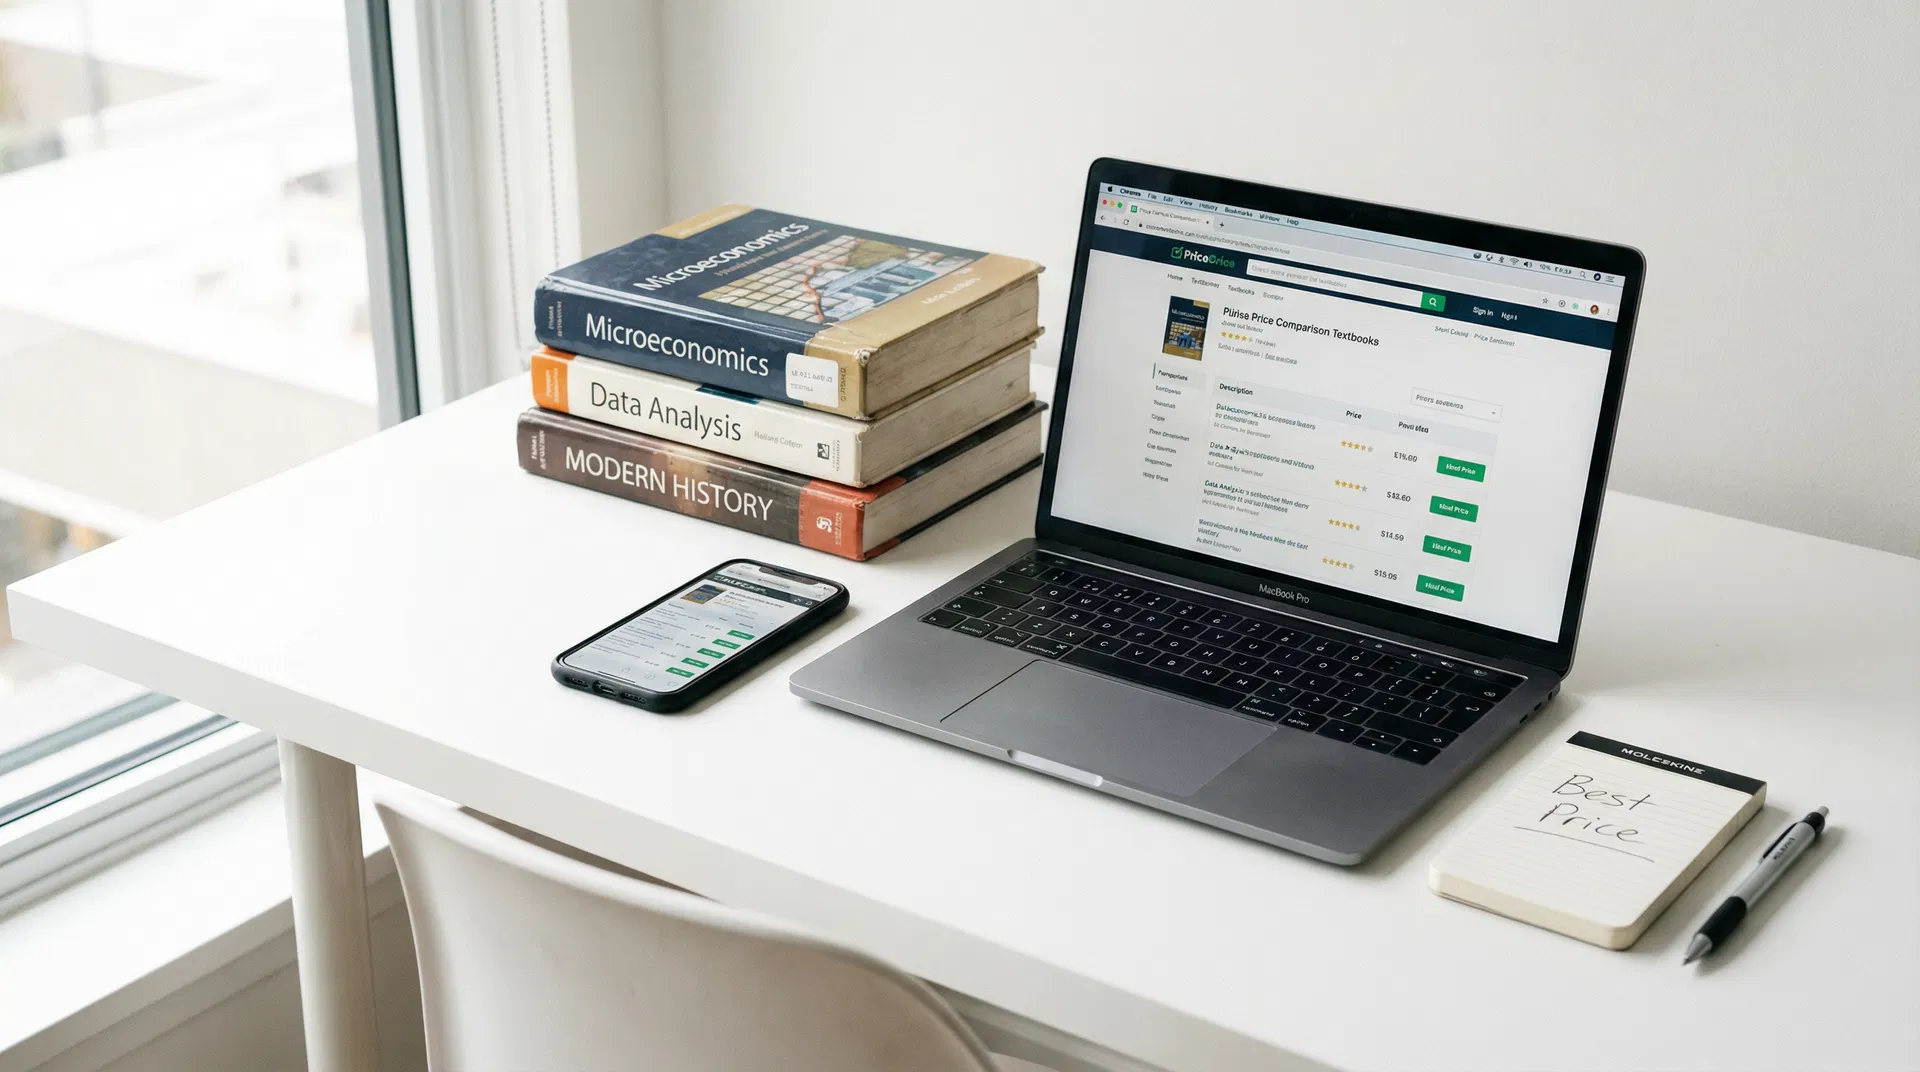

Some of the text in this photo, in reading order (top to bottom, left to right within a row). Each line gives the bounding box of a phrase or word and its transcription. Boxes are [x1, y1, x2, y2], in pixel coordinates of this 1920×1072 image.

[633, 222, 810, 291] Microeconomics
[586, 313, 769, 377] Microeconomics
[1251, 312, 1274, 325] Price
[1275, 318, 1330, 336] Comparison
[1333, 329, 1380, 347] Textbooks
[1219, 383, 1254, 396] Description
[591, 382, 641, 417] Data
[649, 397, 742, 442] Analysis
[1345, 410, 1363, 420] Price
[565, 446, 666, 494] MODERN
[673, 474, 773, 521] HISTORY
[1258, 583, 1310, 604] MacBook Pro
[1621, 747, 1706, 775] MOLESKINE
[1552, 774, 1660, 811] Best
[1539, 803, 1646, 844] Price
